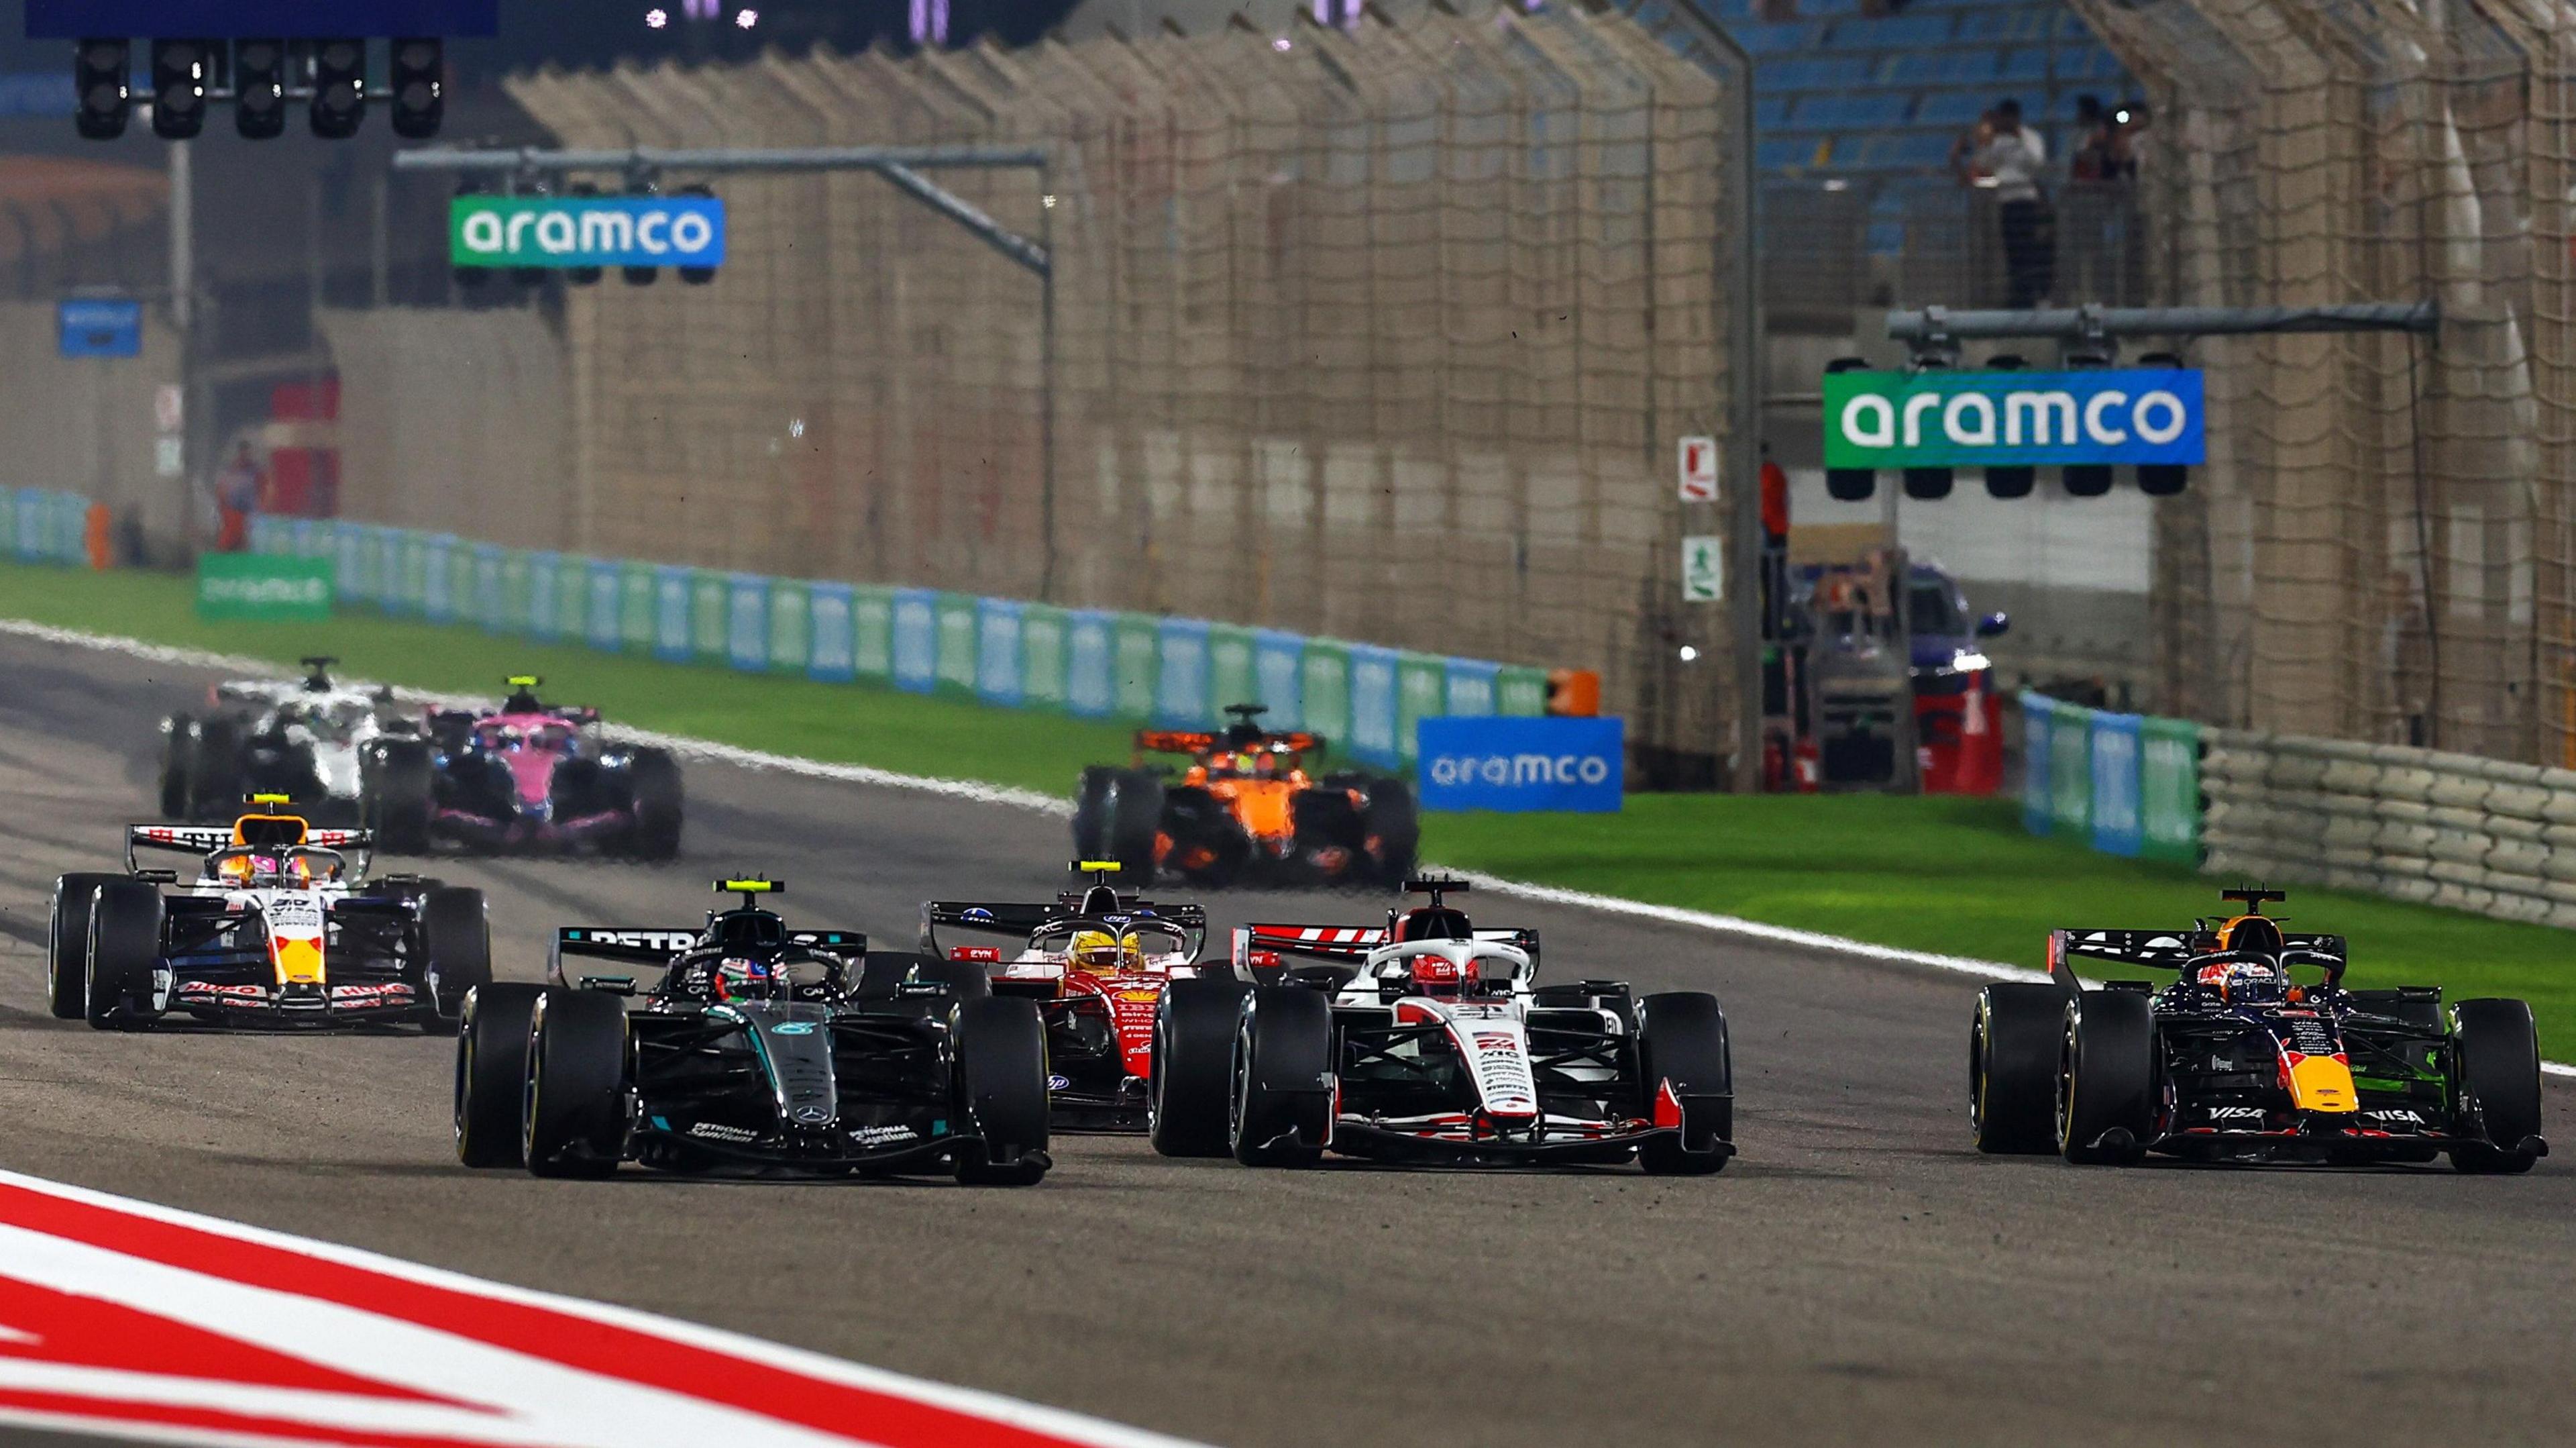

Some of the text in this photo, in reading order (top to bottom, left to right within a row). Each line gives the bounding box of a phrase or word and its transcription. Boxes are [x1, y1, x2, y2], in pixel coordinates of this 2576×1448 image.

[463, 210, 712, 254] aramco
[1841, 391, 2186, 448] aramco
[1432, 754, 1608, 787] aramco
[2208, 1107, 2267, 1119] VISA
[2363, 1110, 2425, 1125] VISA
[694, 1123, 758, 1137] PETRONAS
